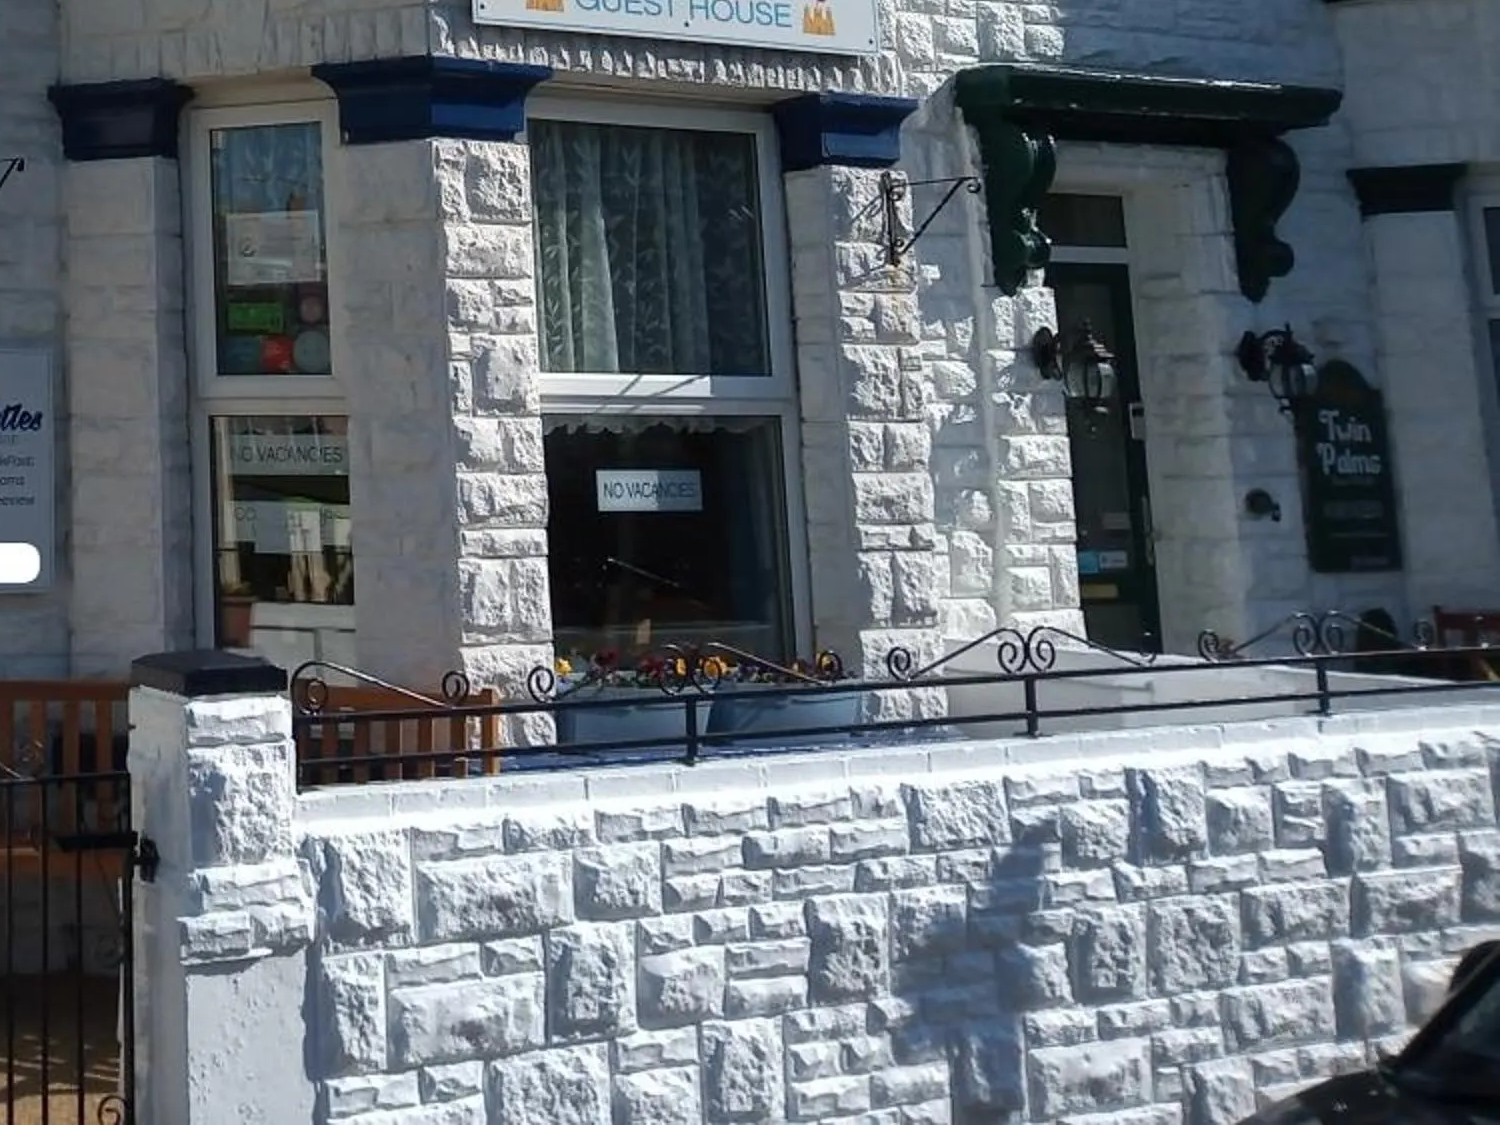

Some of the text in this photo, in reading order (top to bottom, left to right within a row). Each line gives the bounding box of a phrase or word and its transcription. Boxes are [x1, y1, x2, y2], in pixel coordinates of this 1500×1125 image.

[1318, 409, 1372, 442] Twin
[256, 445, 343, 463] VACANCIES
[1315, 442, 1382, 475] Palms
[603, 481, 696, 499] NO VACANCIES
